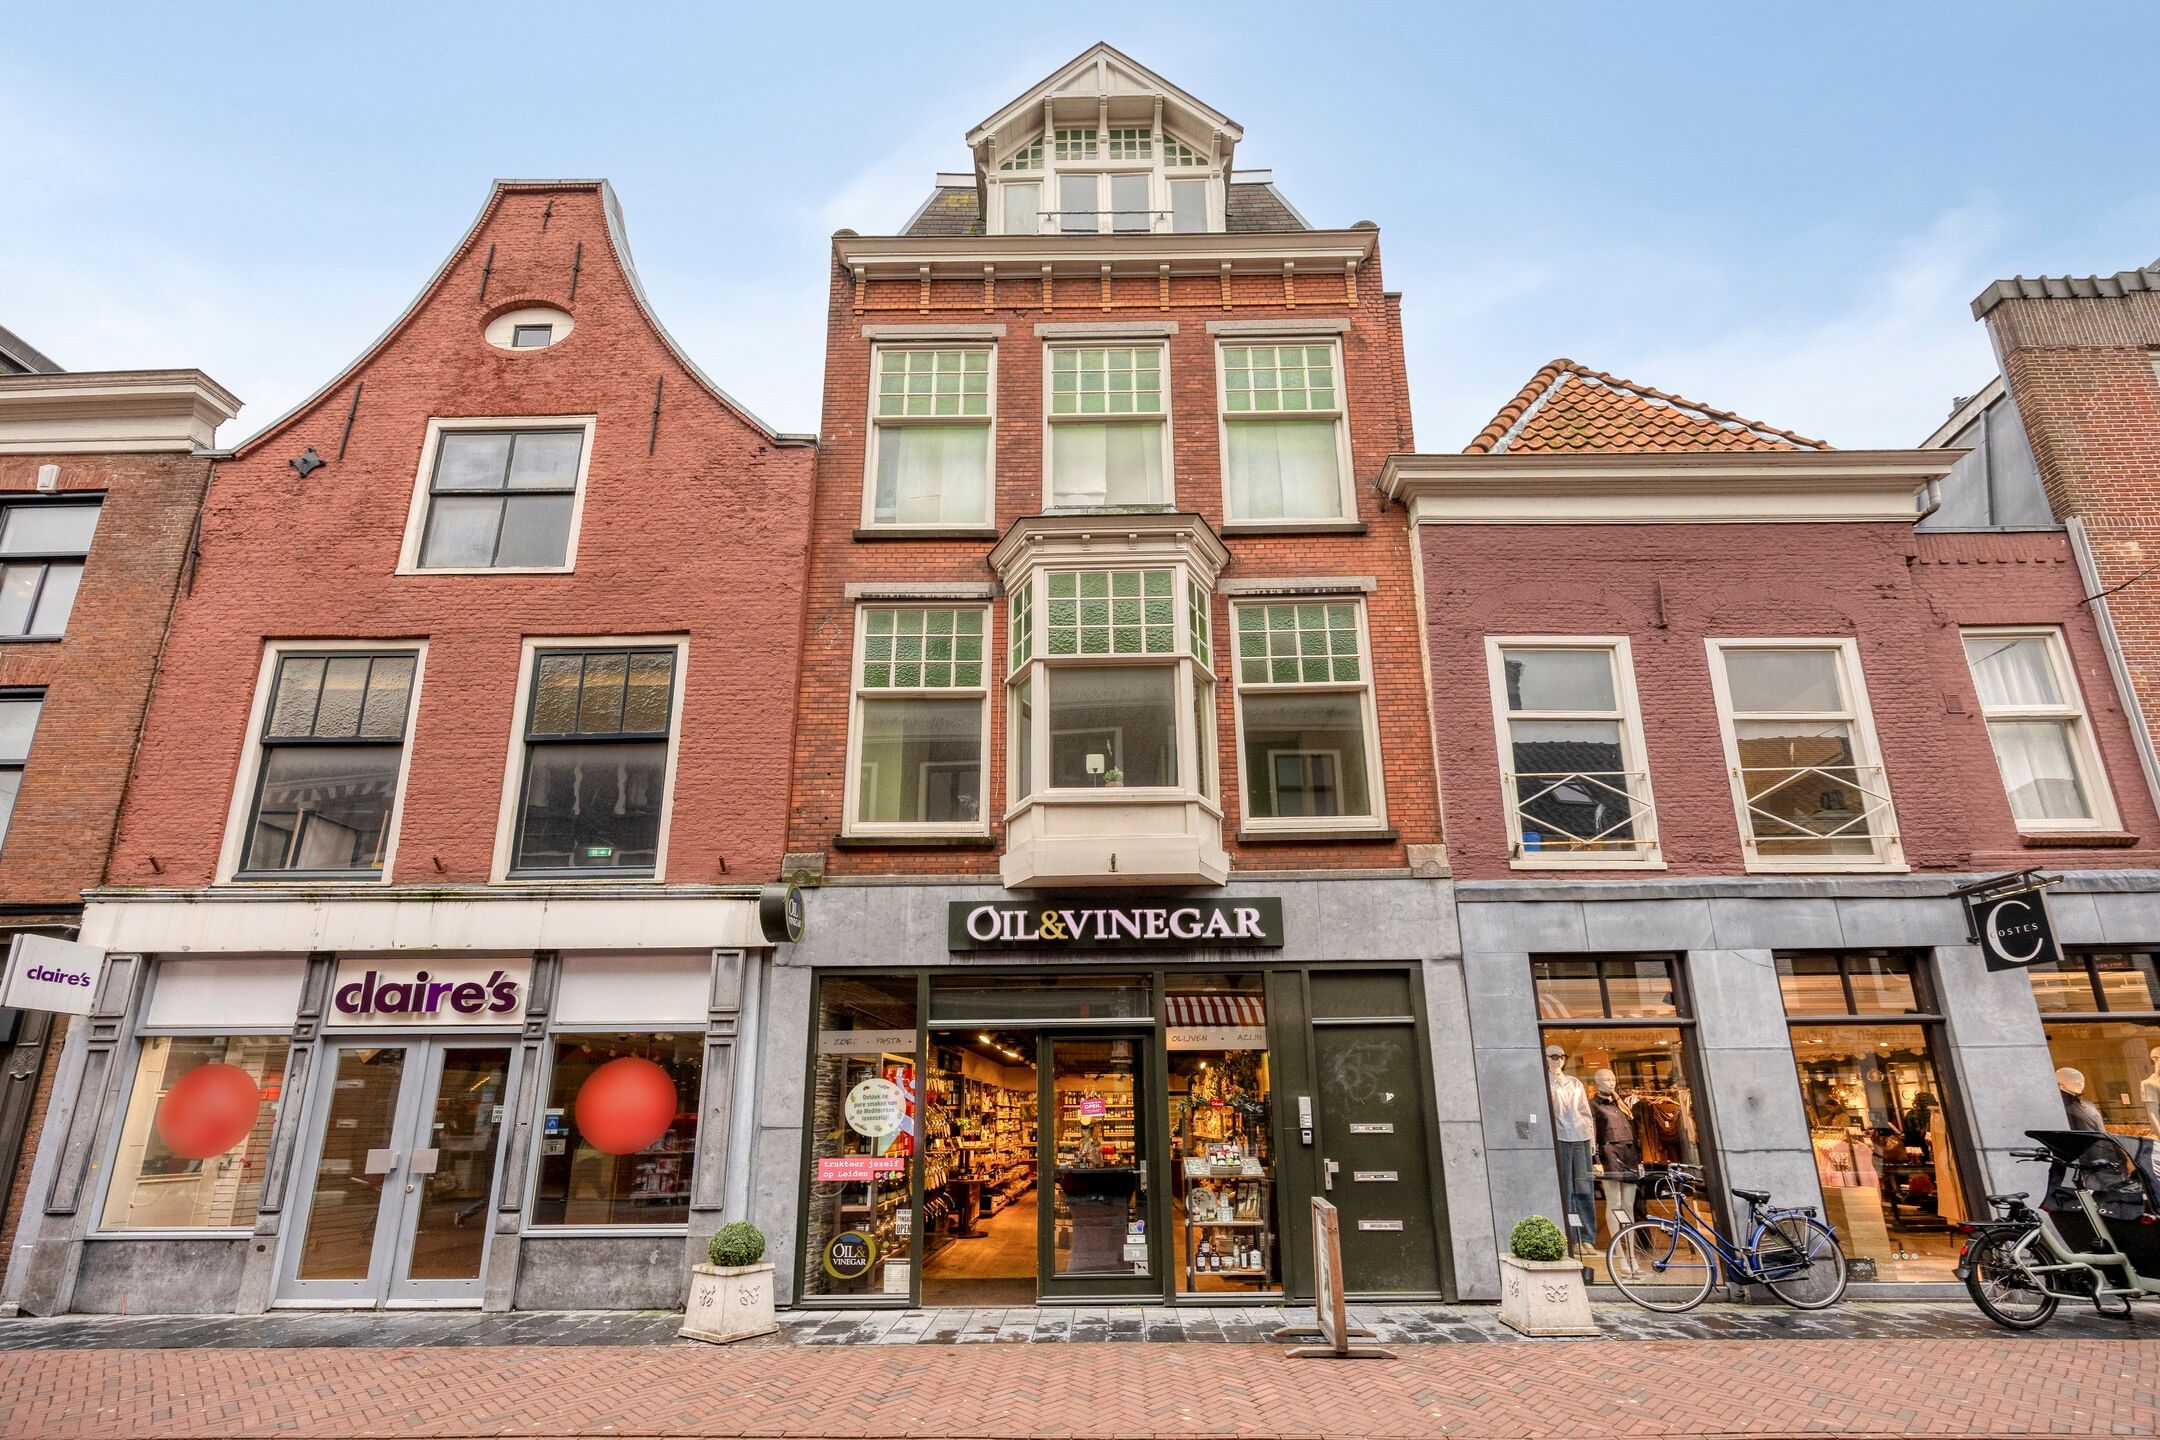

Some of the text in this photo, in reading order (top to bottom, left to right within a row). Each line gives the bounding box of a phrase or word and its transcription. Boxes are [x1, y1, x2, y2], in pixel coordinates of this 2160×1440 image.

[26, 964, 92, 987] claire's
[334, 970, 519, 1014] claire's
[833, 1037, 857, 1046] ZOET
[876, 1036, 902, 1045] PASTA
[1171, 1034, 1208, 1043] OLIJVEN
[823, 1160, 900, 1169] trakteer jezelf
[833, 1243, 865, 1258] OIL&
